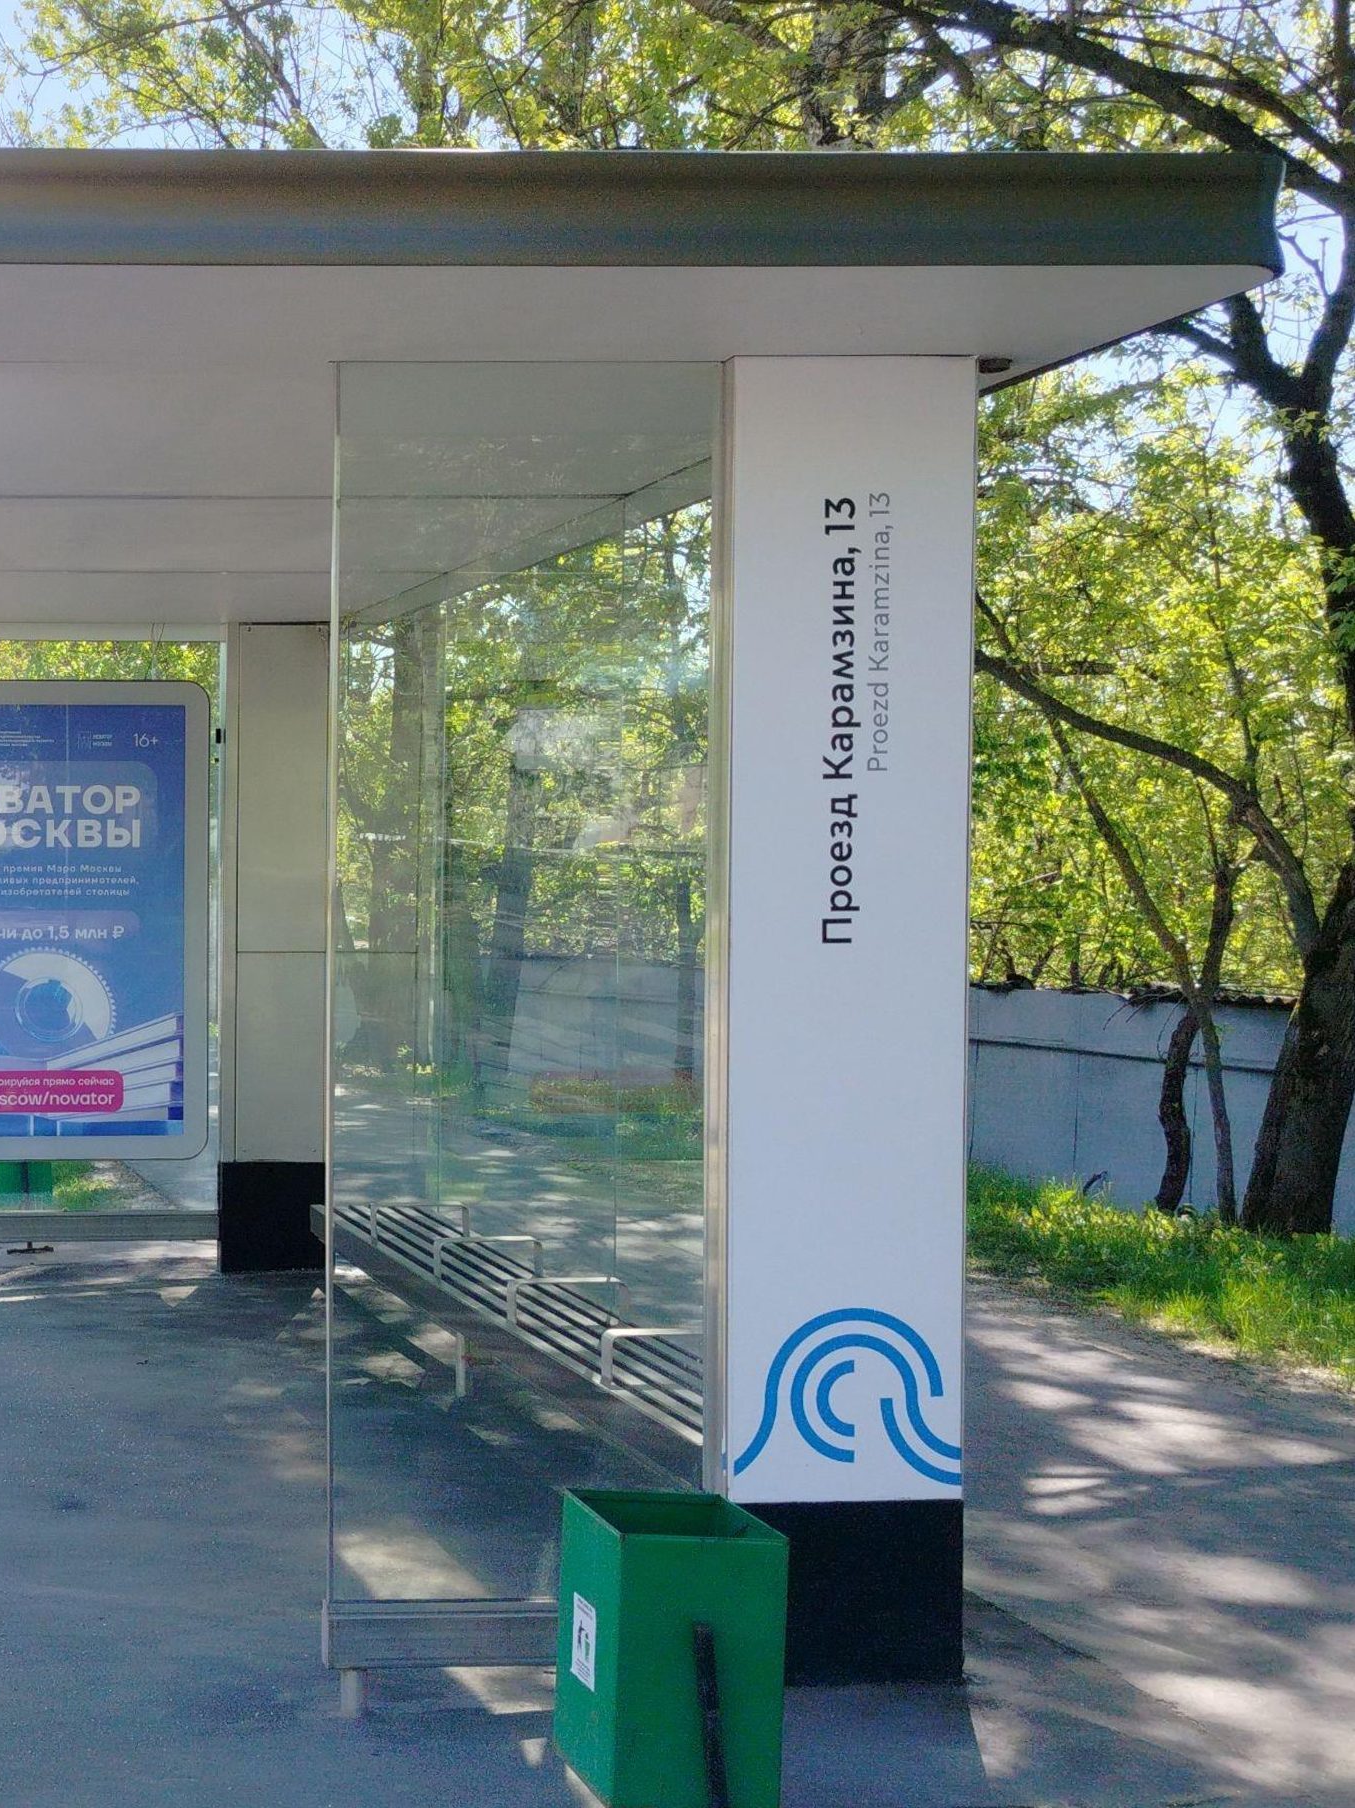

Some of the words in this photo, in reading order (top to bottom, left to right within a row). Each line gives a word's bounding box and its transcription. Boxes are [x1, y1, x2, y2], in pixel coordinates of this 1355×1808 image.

[824, 497, 856, 536] 13
[869, 492, 891, 518] 13
[867, 524, 893, 671] Karamzina,
[822, 546, 861, 779] Карамзина,
[867, 682, 890, 772] Proezd
[133, 733, 159, 748] 16+
[80, 864, 122, 873] Москвы
[821, 793, 860, 944] Проезд
[86, 888, 130, 897] столицы
[21, 926, 42, 941] до
[48, 925, 70, 942] 1,5
[75, 927, 107, 940] млн
[43, 1077, 75, 1088] прямо
[78, 1076, 115, 1086] сейчас
